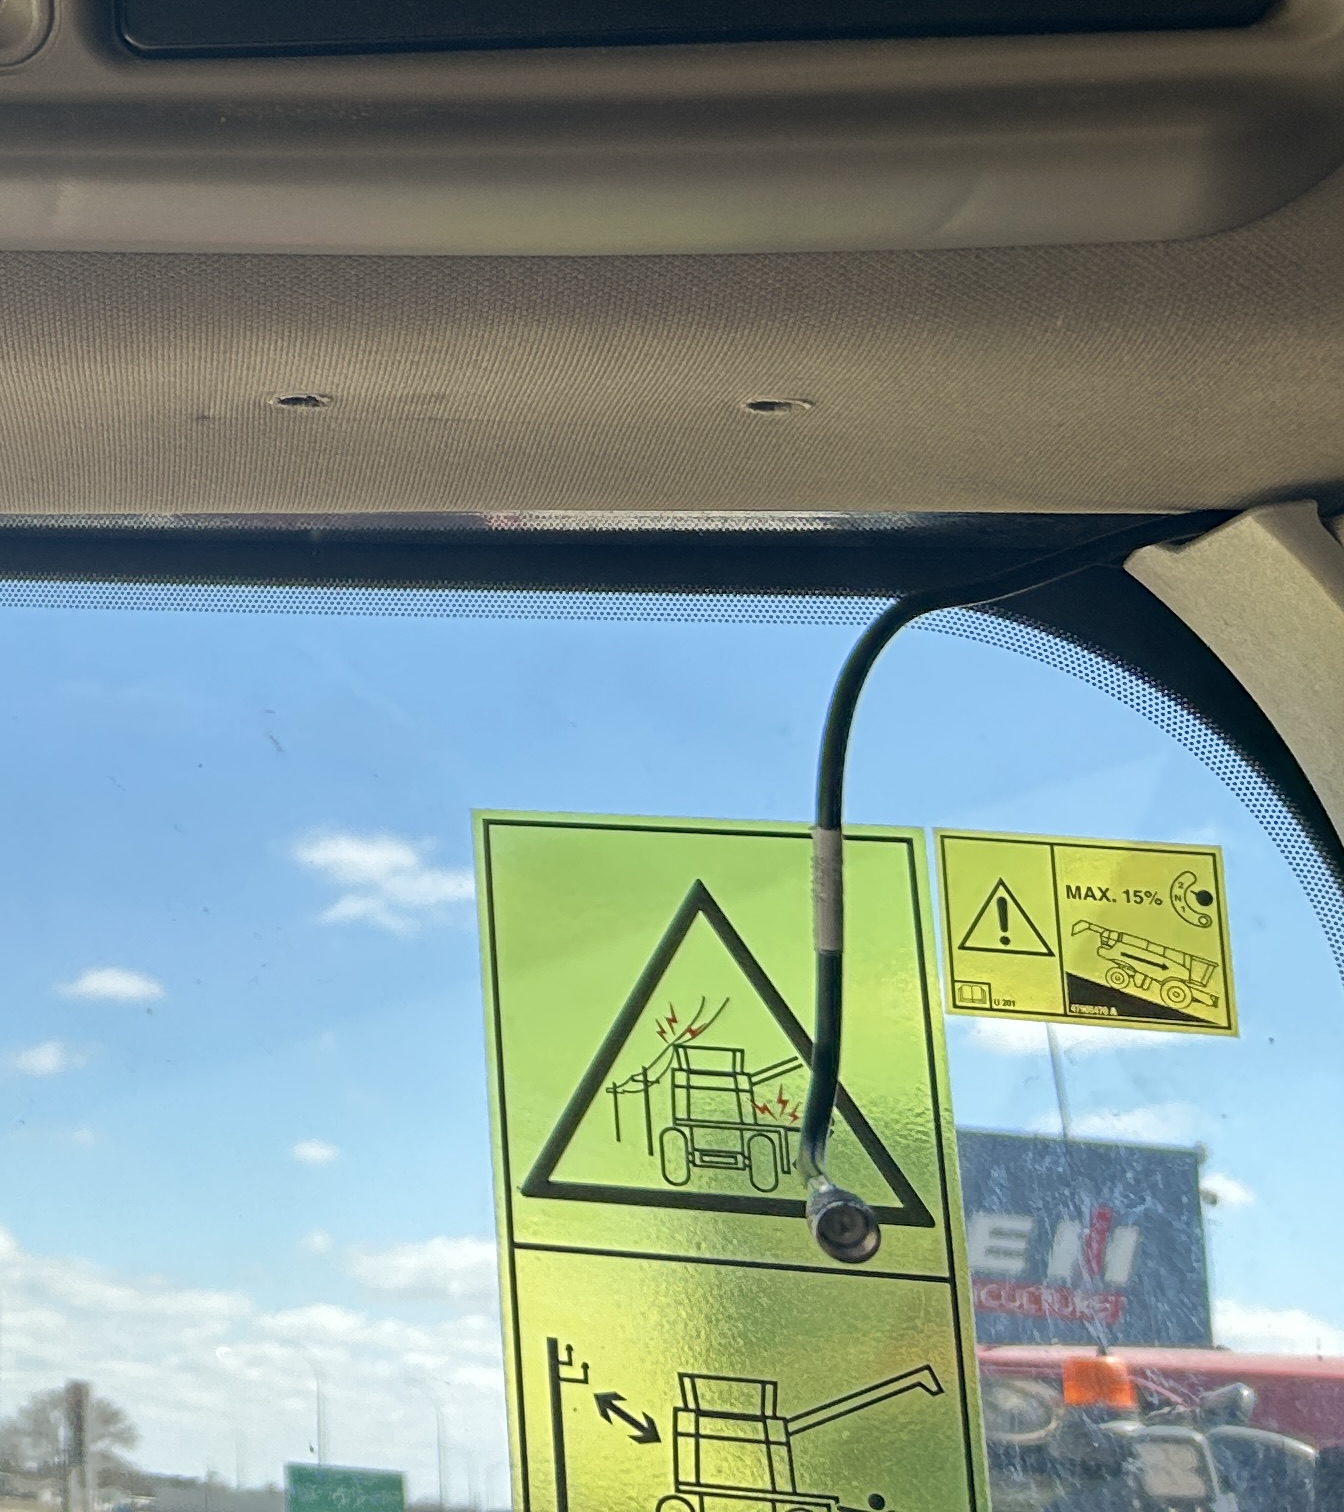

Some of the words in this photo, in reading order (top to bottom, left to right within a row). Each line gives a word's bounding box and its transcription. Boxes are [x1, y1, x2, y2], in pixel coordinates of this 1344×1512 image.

[1065, 884, 1117, 903] MAX.
[1123, 888, 1164, 906] 15%
[1174, 894, 1182, 902] N
